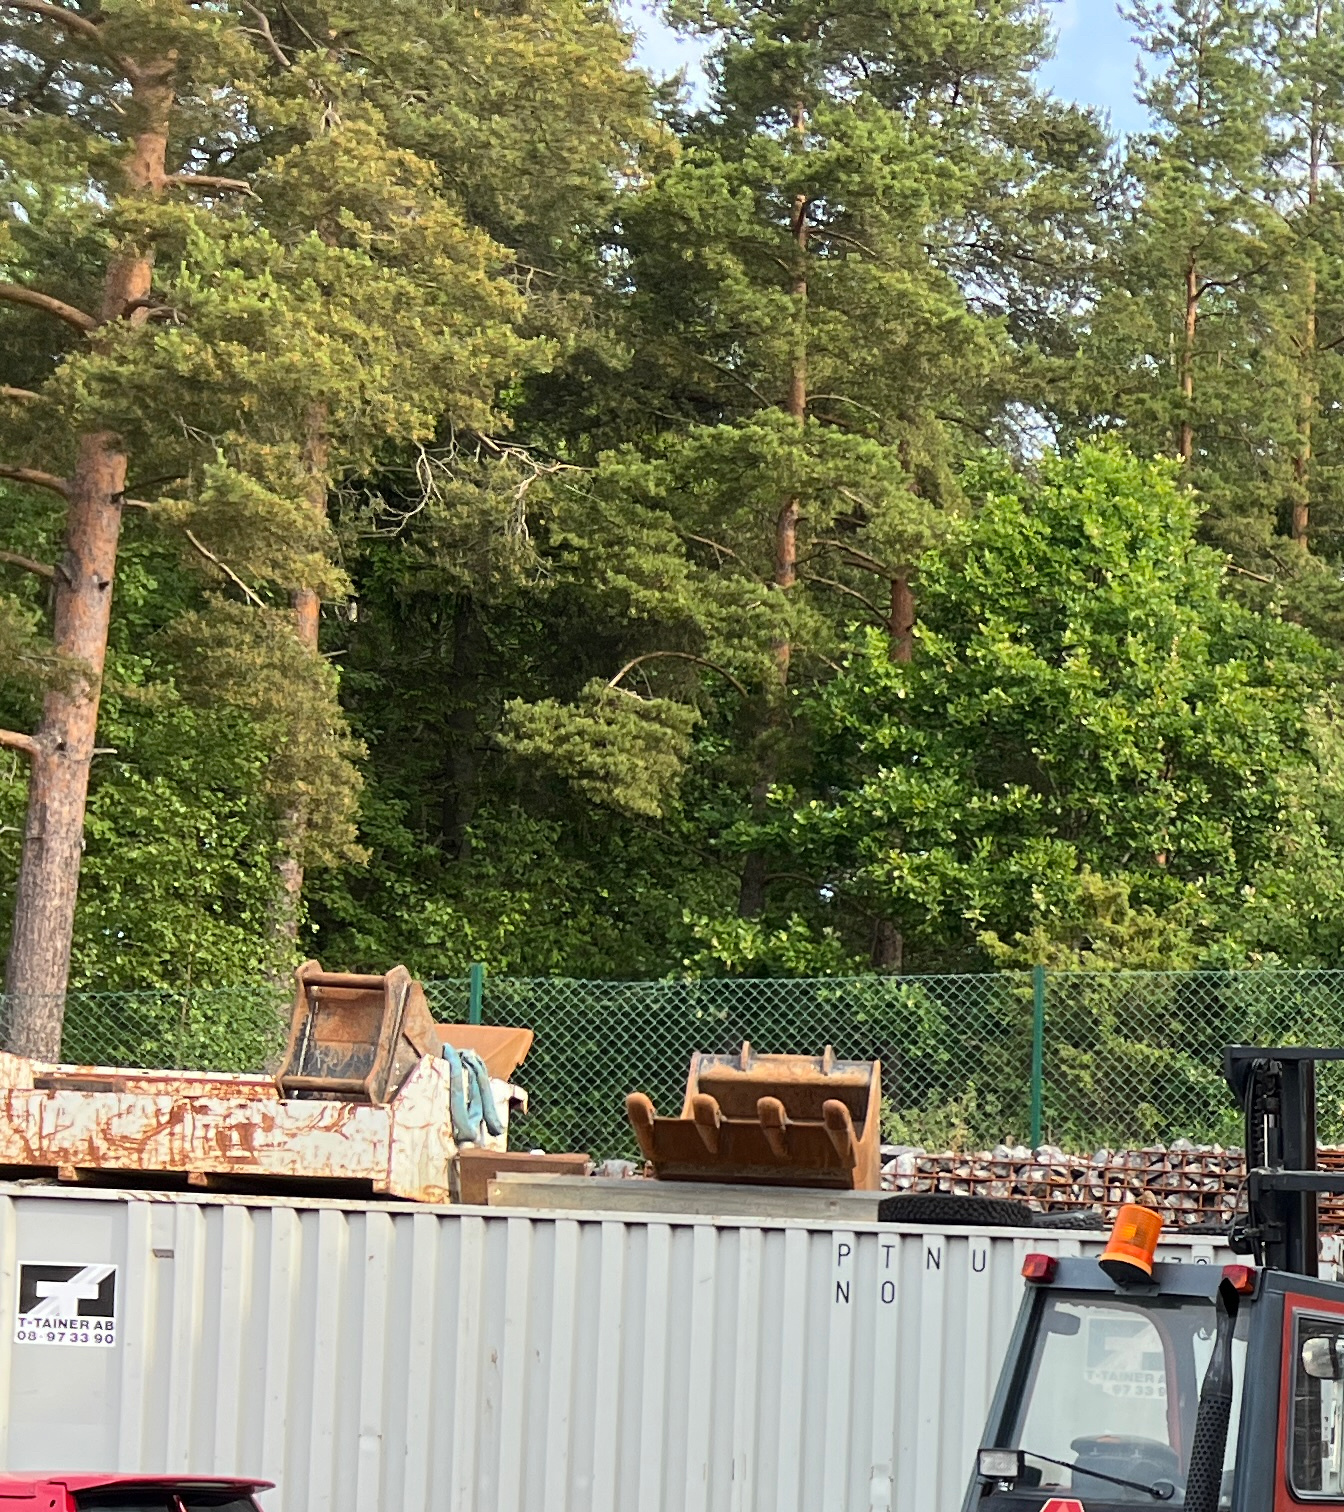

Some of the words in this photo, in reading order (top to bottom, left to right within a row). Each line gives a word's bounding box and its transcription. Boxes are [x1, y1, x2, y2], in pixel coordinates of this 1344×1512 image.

[18, 1317, 90, 1330] T-TAINER
[94, 1320, 114, 1331] AB
[69, 1332, 89, 1343] 33
[94, 1333, 114, 1344] 90
